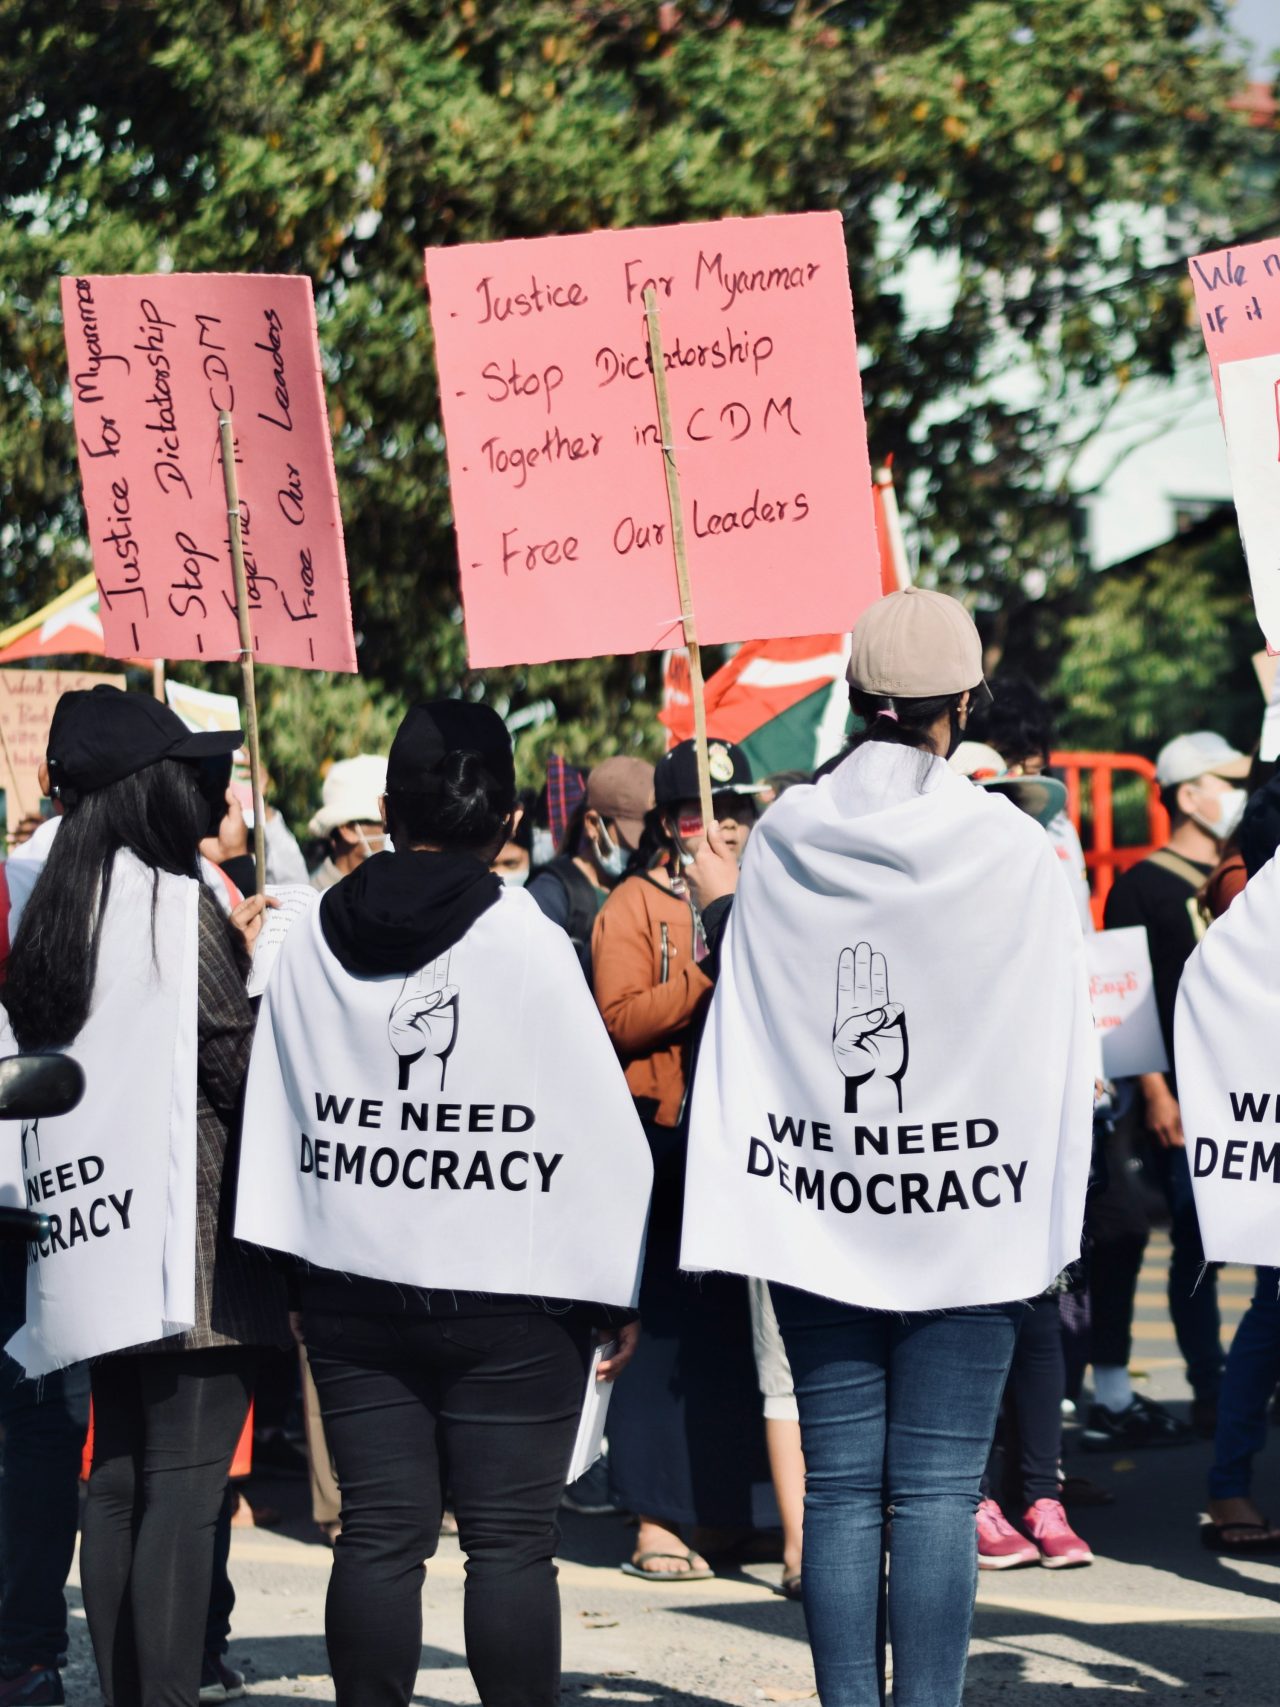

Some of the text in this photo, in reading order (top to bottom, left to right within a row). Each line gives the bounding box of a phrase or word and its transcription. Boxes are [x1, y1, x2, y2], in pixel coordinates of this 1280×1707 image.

[476, 275, 589, 325] Justice
[695, 249, 821, 312] Myanmar
[1192, 251, 1247, 291] We
[1245, 296, 1263, 321] it
[74, 278, 130, 403] Myanmar
[195, 314, 236, 414] CDM
[481, 326, 775, 415] Stop Dictatorship
[135, 298, 220, 620] Stop Dictatorship
[254, 307, 319, 623] Free Our Leaders
[481, 425, 603, 488] Together
[97, 475, 149, 618] Justice
[501, 488, 809, 576] Free Our Leaders
[313, 1091, 536, 1134] WE NEED
[766, 1112, 999, 1157] WE NEED
[27, 1155, 104, 1206] NEED
[299, 1134, 563, 1194] DEMOCRACY
[746, 1135, 1029, 1215] DEMOCRACY
